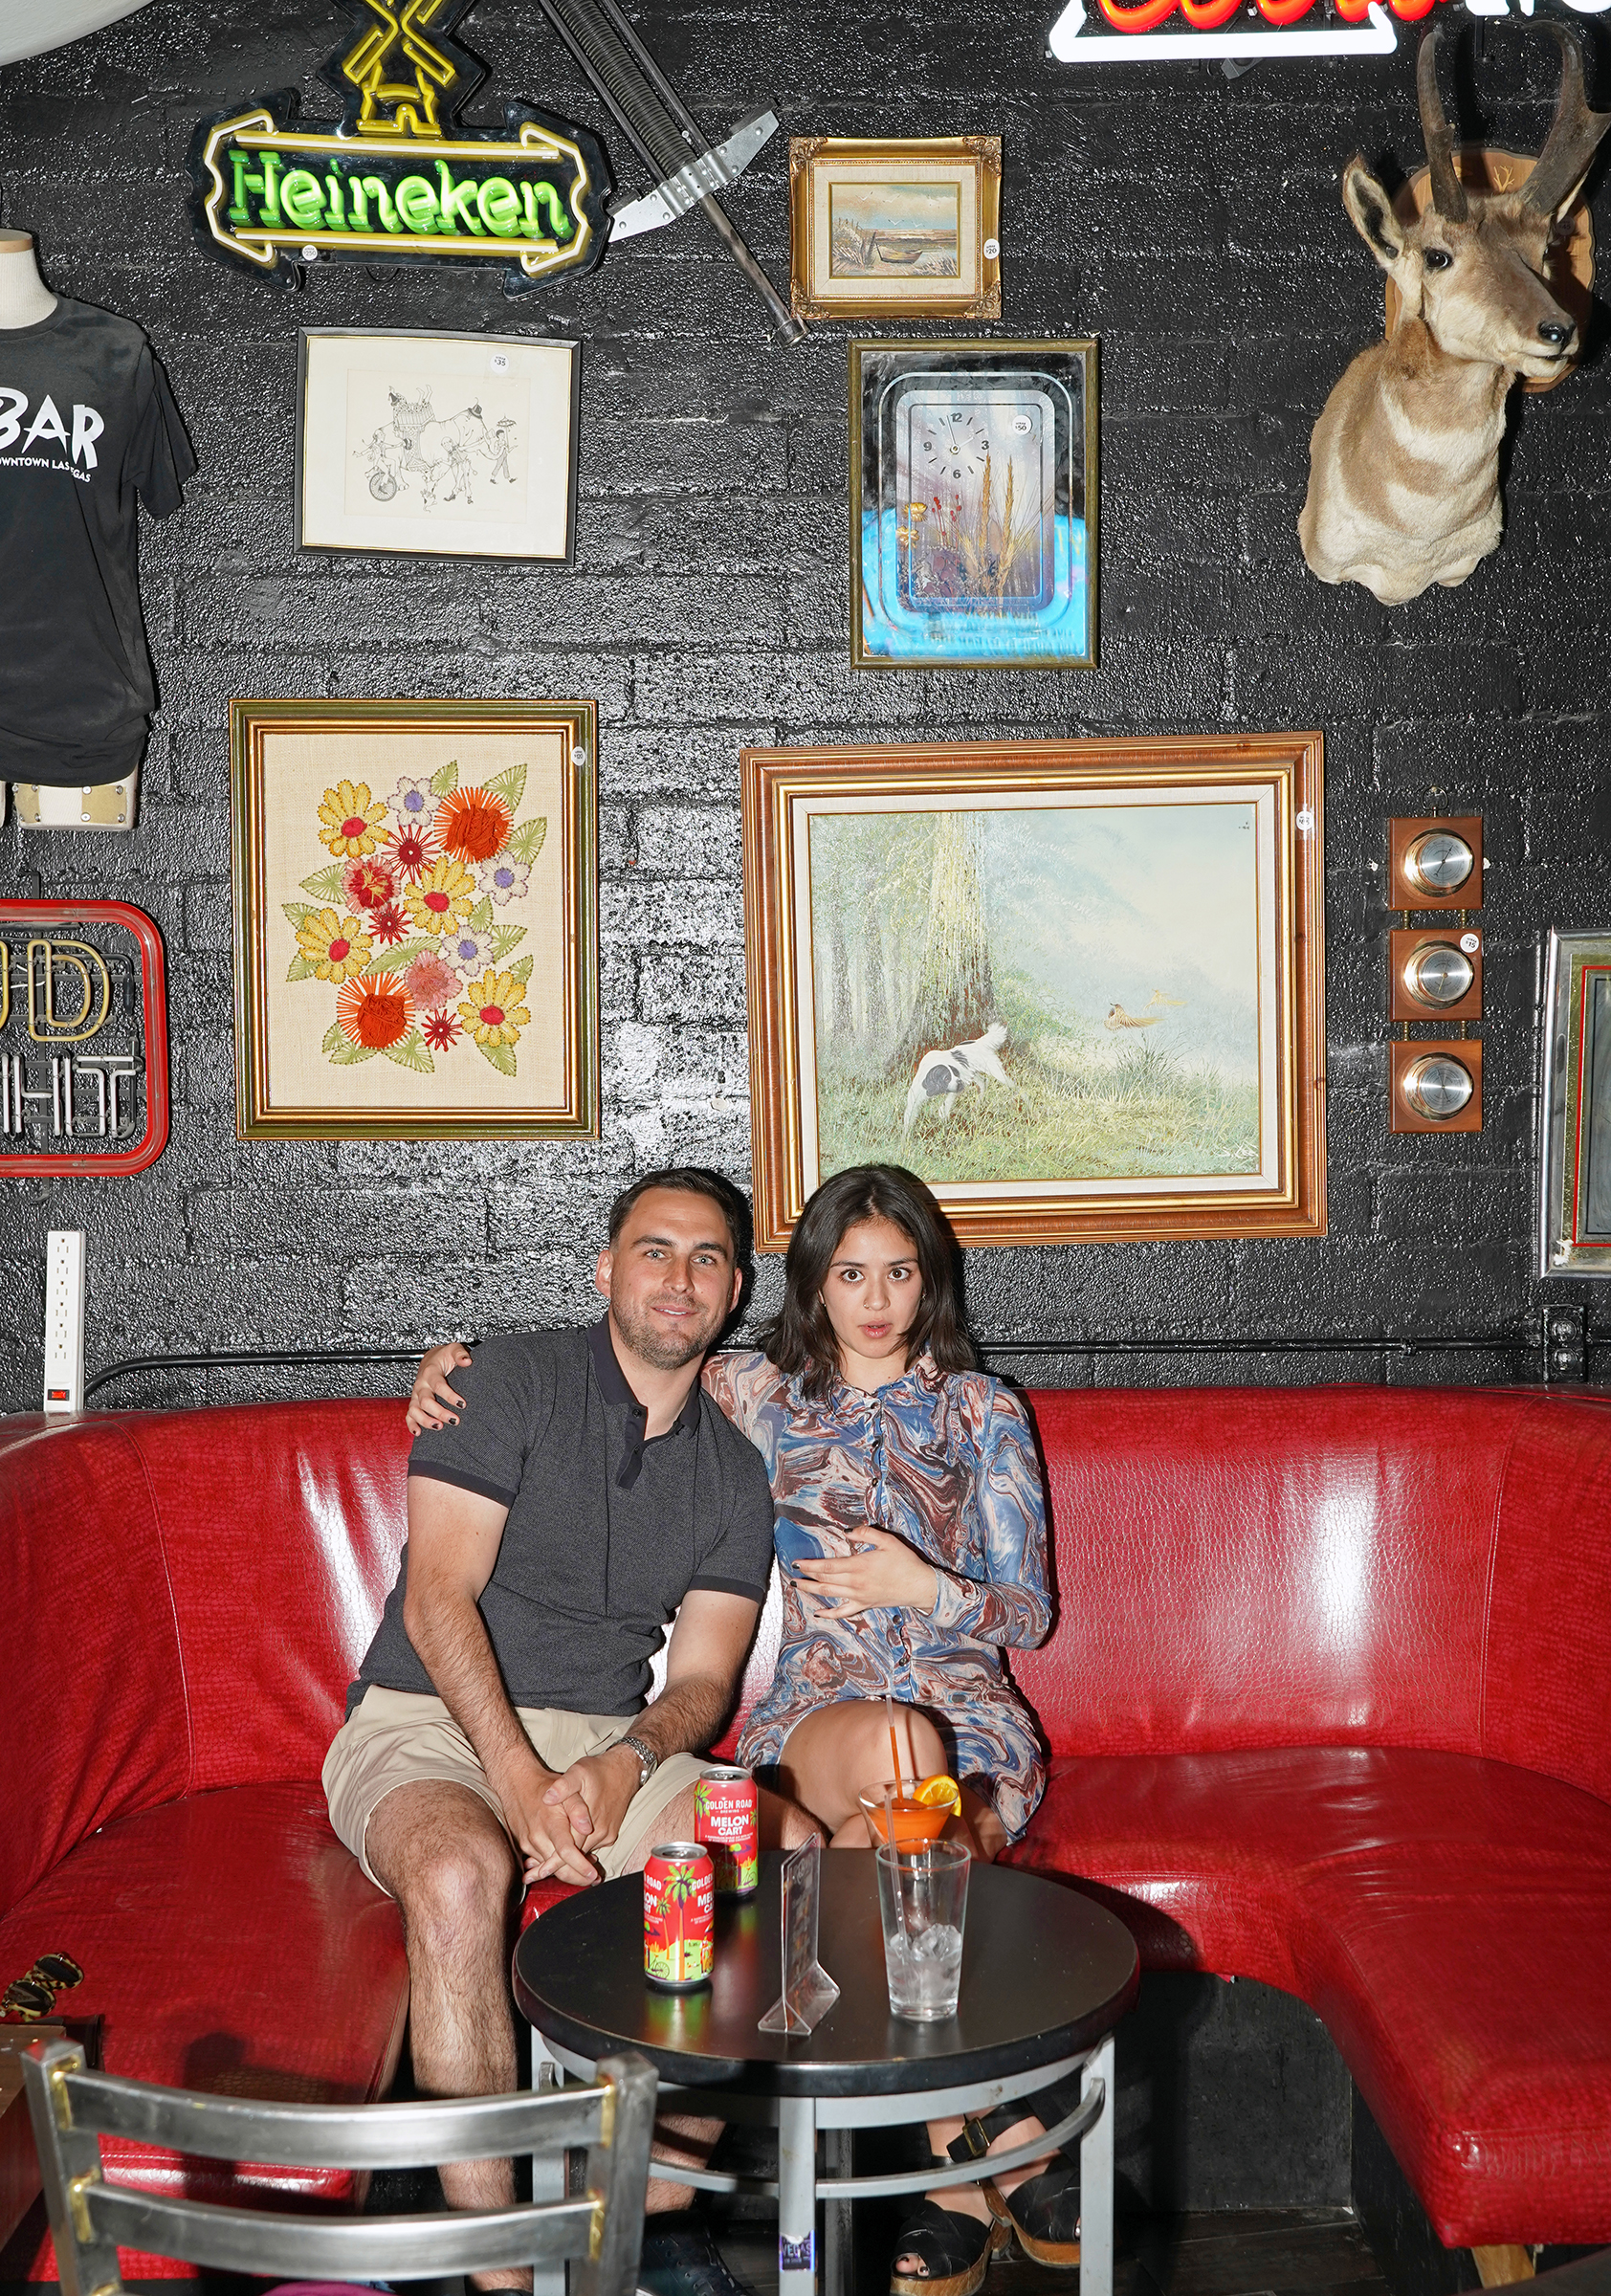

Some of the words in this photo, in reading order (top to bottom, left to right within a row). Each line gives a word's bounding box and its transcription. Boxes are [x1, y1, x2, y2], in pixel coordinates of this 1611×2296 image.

[229, 150, 574, 238] Heineken
[951, 412, 963, 423] 12
[923, 441, 933, 452] 9
[981, 440, 990, 451] 3
[52, 460, 70, 471] LAS
[952, 469, 961, 479] 6
[705, 1799, 734, 1810] GOLDEN
[736, 1799, 753, 1808] ROAD
[711, 1814, 749, 1827] MELON
[717, 1825, 743, 1836] CART
[647, 1874, 662, 1890] ROAD
[644, 1891, 657, 1908] ON
